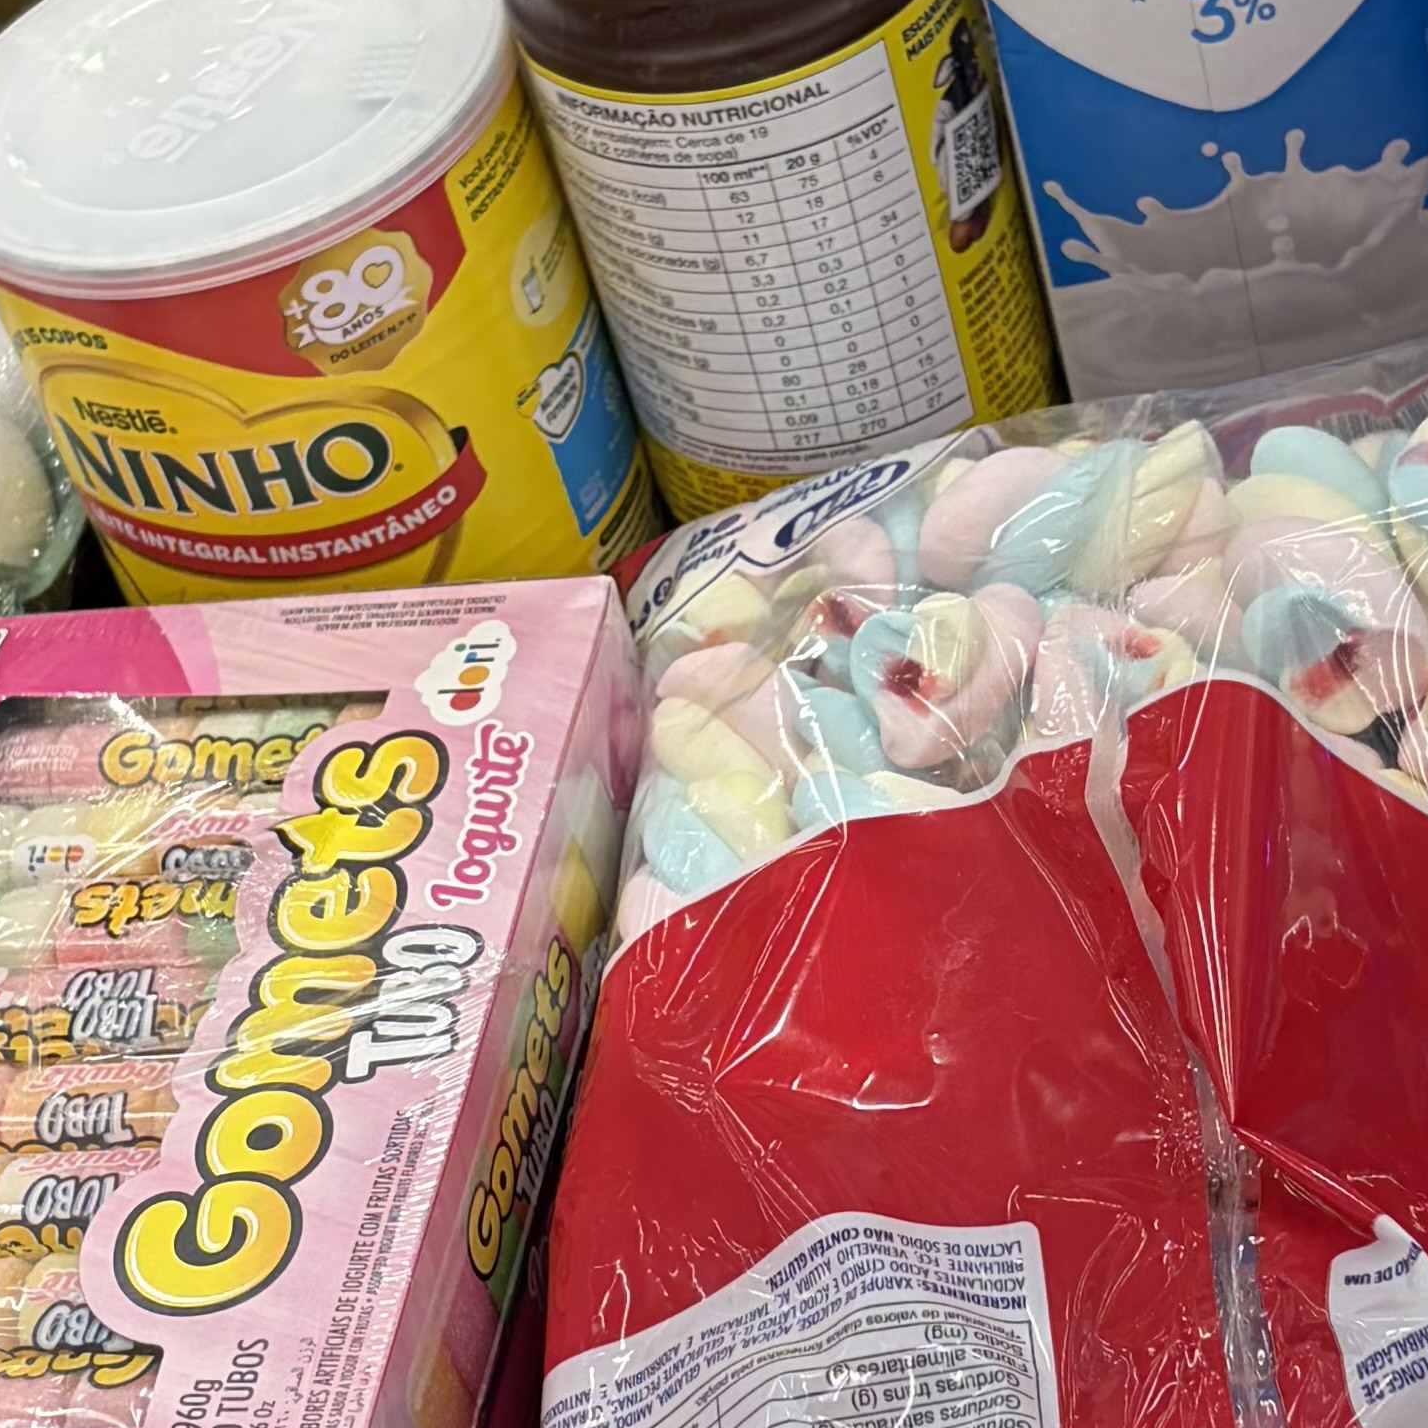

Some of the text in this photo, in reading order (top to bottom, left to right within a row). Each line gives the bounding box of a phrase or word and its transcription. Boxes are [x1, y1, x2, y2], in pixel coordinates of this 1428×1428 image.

[682, 82, 830, 128] NUTRICIONAL
[676, 126, 769, 149] Cerca de 19
[785, 155, 806, 170] 20
[702, 173, 727, 186] 100
[798, 174, 819, 190] 75
[736, 194, 825, 226] 12 18
[817, 237, 834, 253] 17
[39, 326, 109, 351] COPOS
[341, 305, 386, 340] ANOS
[329, 348, 350, 364] DO
[71, 396, 168, 435] Nestlé
[793, 433, 821, 447] 217
[925, 392, 942, 410] 27
[53, 413, 393, 516] NINHO
[140, 485, 458, 565] INTEGRAL INSTANTÂNEO
[341, 924, 485, 1084] TUBO
[113, 729, 450, 1318] Gomets
[35, 1091, 135, 1146] TUBO
[467, 934, 576, 1281] Gomets
[364, 1161, 396, 1210] FRUTAS
[358, 1204, 380, 1236] COM
[864, 1227, 895, 1247] NÃO
[945, 1239, 964, 1255] DE
[969, 1239, 1022, 1256] LACTATO
[341, 1232, 376, 1289] IOGURTE
[335, 1290, 359, 1312] DE
[860, 1276, 915, 1296] XAROPE
[312, 1313, 352, 1389] ARTIFICIAIS
[855, 1347, 967, 1374] alimentares
[215, 1338, 270, 1418] TUBOS
[851, 1369, 1020, 1413] Gorduras trans (g)
[252, 1400, 276, 1419] Oz
[940, 1393, 1021, 1421] Gorduras
